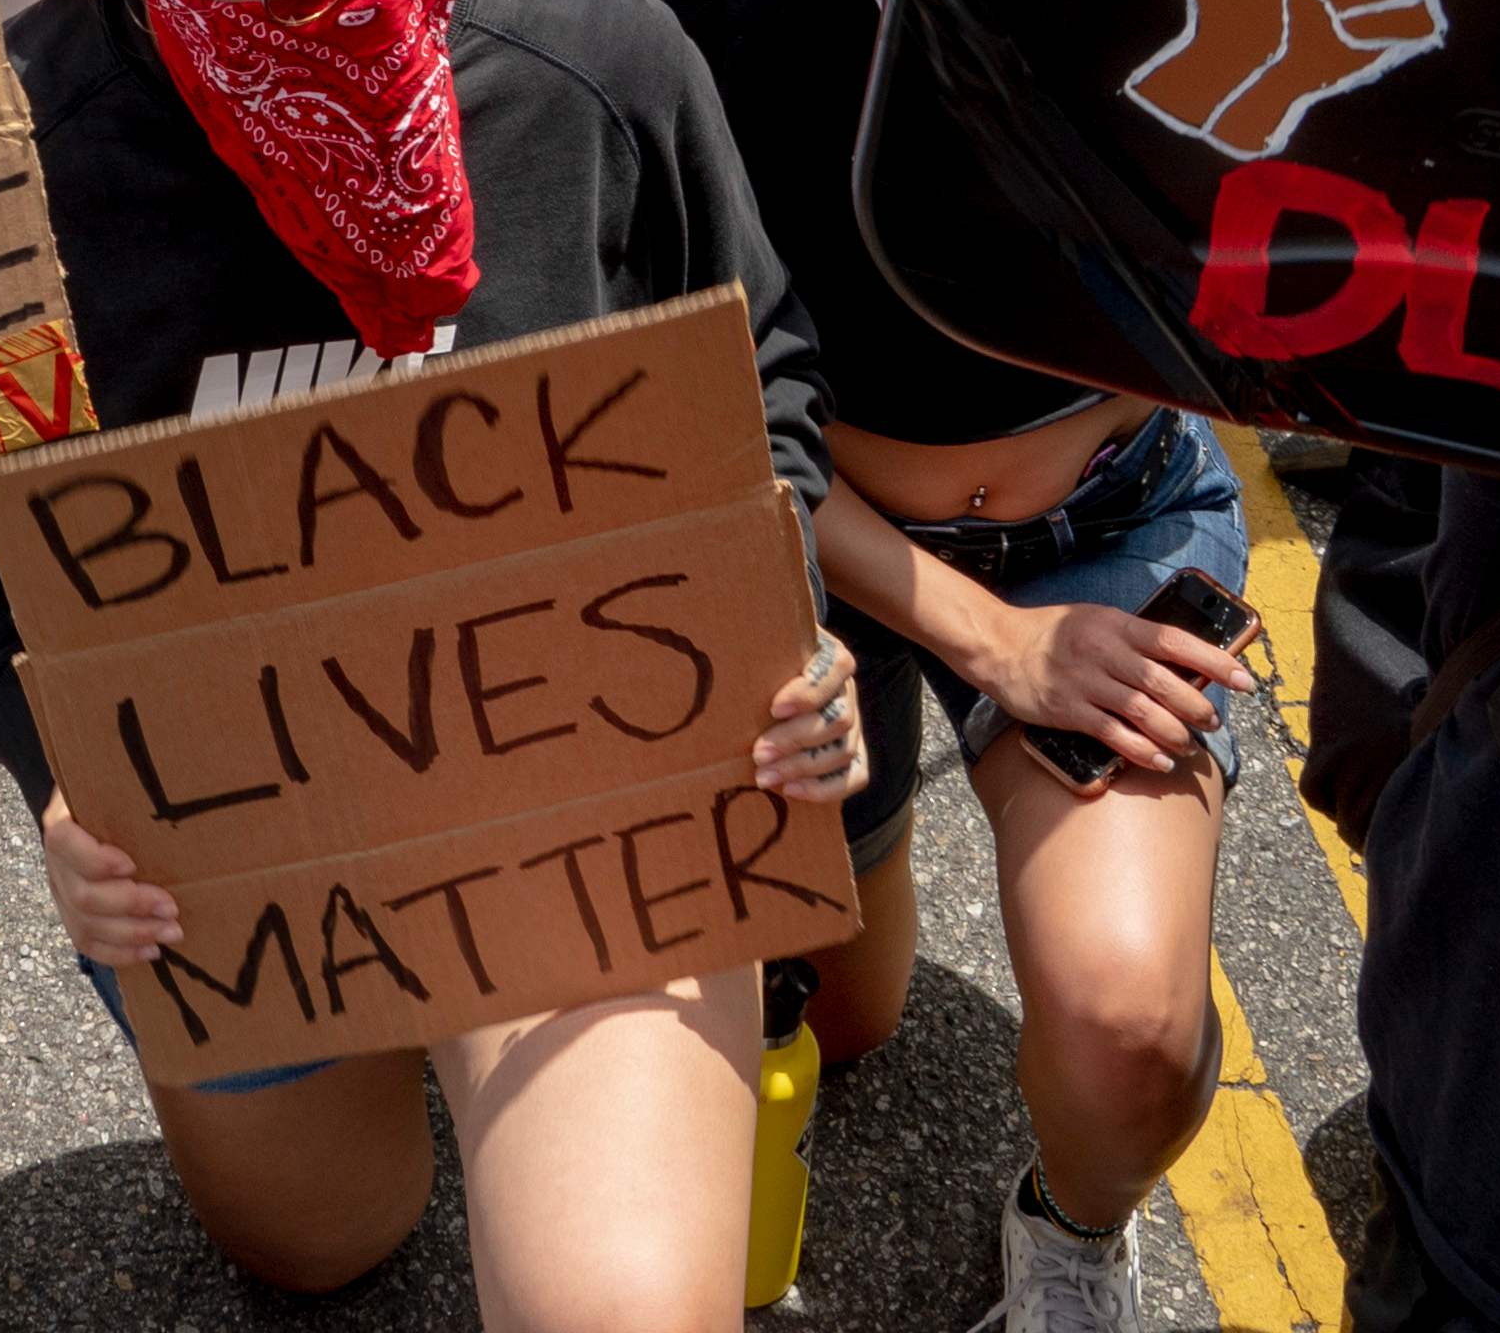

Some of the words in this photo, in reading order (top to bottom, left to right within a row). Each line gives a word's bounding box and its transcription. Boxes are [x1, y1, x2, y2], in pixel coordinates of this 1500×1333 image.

[26, 369, 671, 613] BLACK
[114, 571, 715, 828] LIVES
[143, 783, 849, 1048] MATTER
